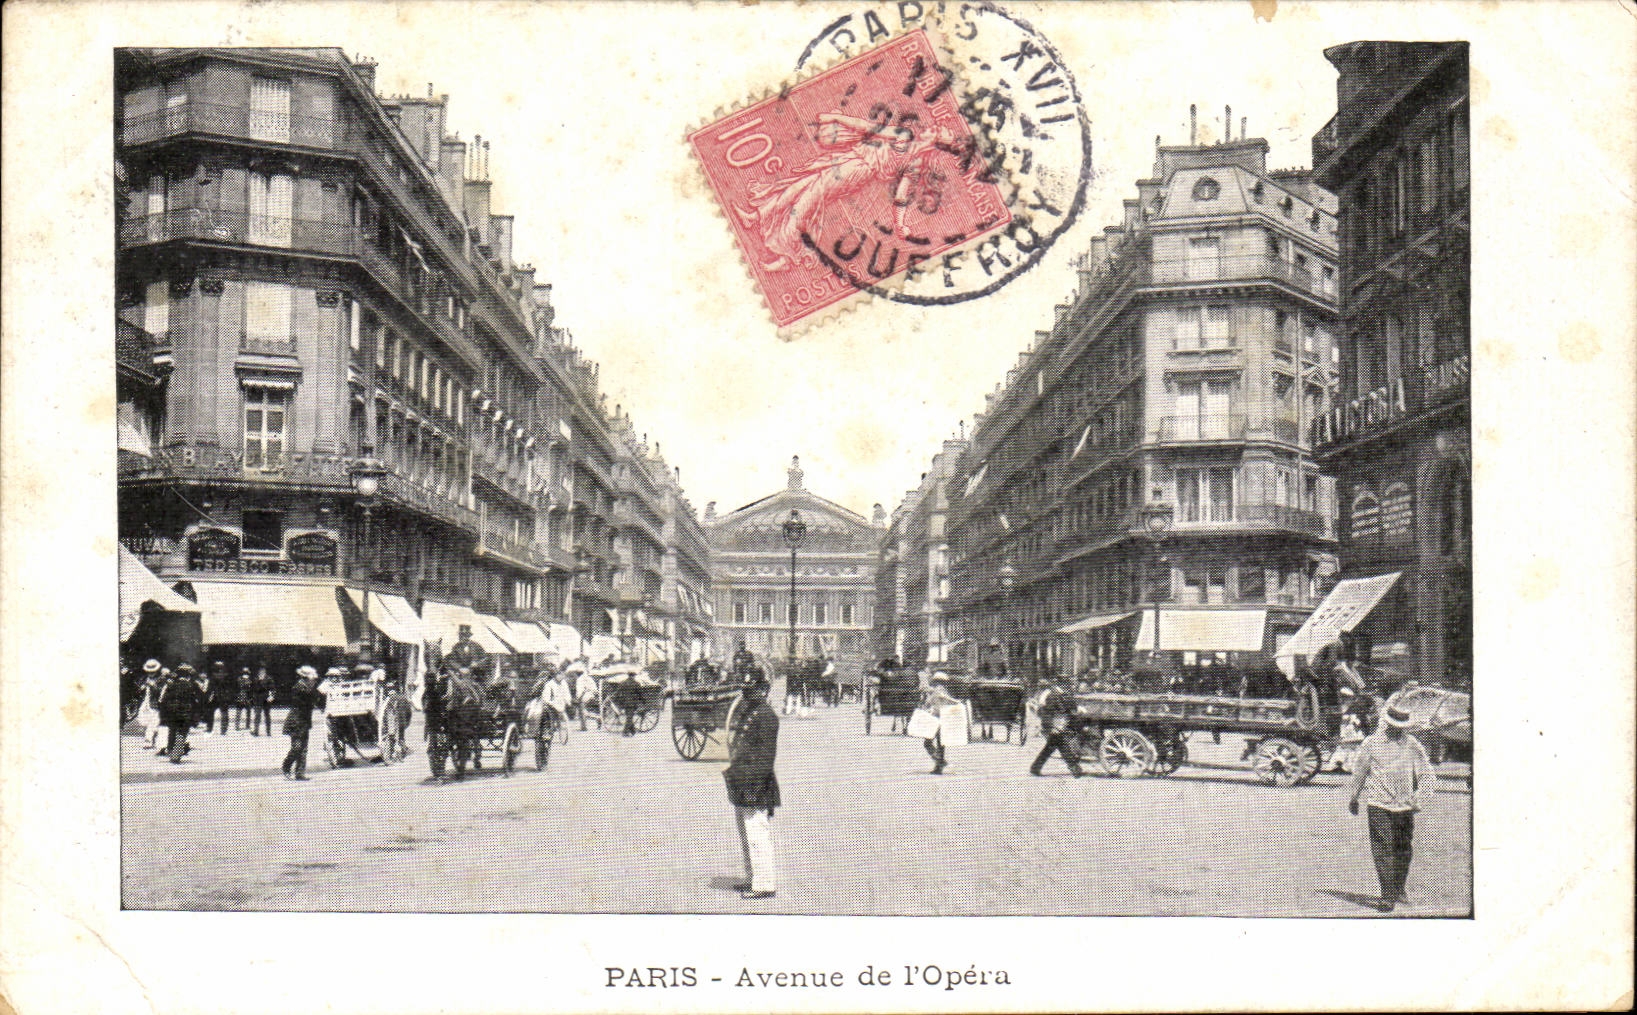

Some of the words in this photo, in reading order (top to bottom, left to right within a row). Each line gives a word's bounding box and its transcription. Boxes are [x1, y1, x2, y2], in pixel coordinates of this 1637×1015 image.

[829, 1, 977, 59] PARIS
[901, 42, 952, 125] REUBLQUE
[863, 102, 915, 152] 25
[781, 262, 862, 312] POSTES
[193, 559, 269, 573] TEDESCO
